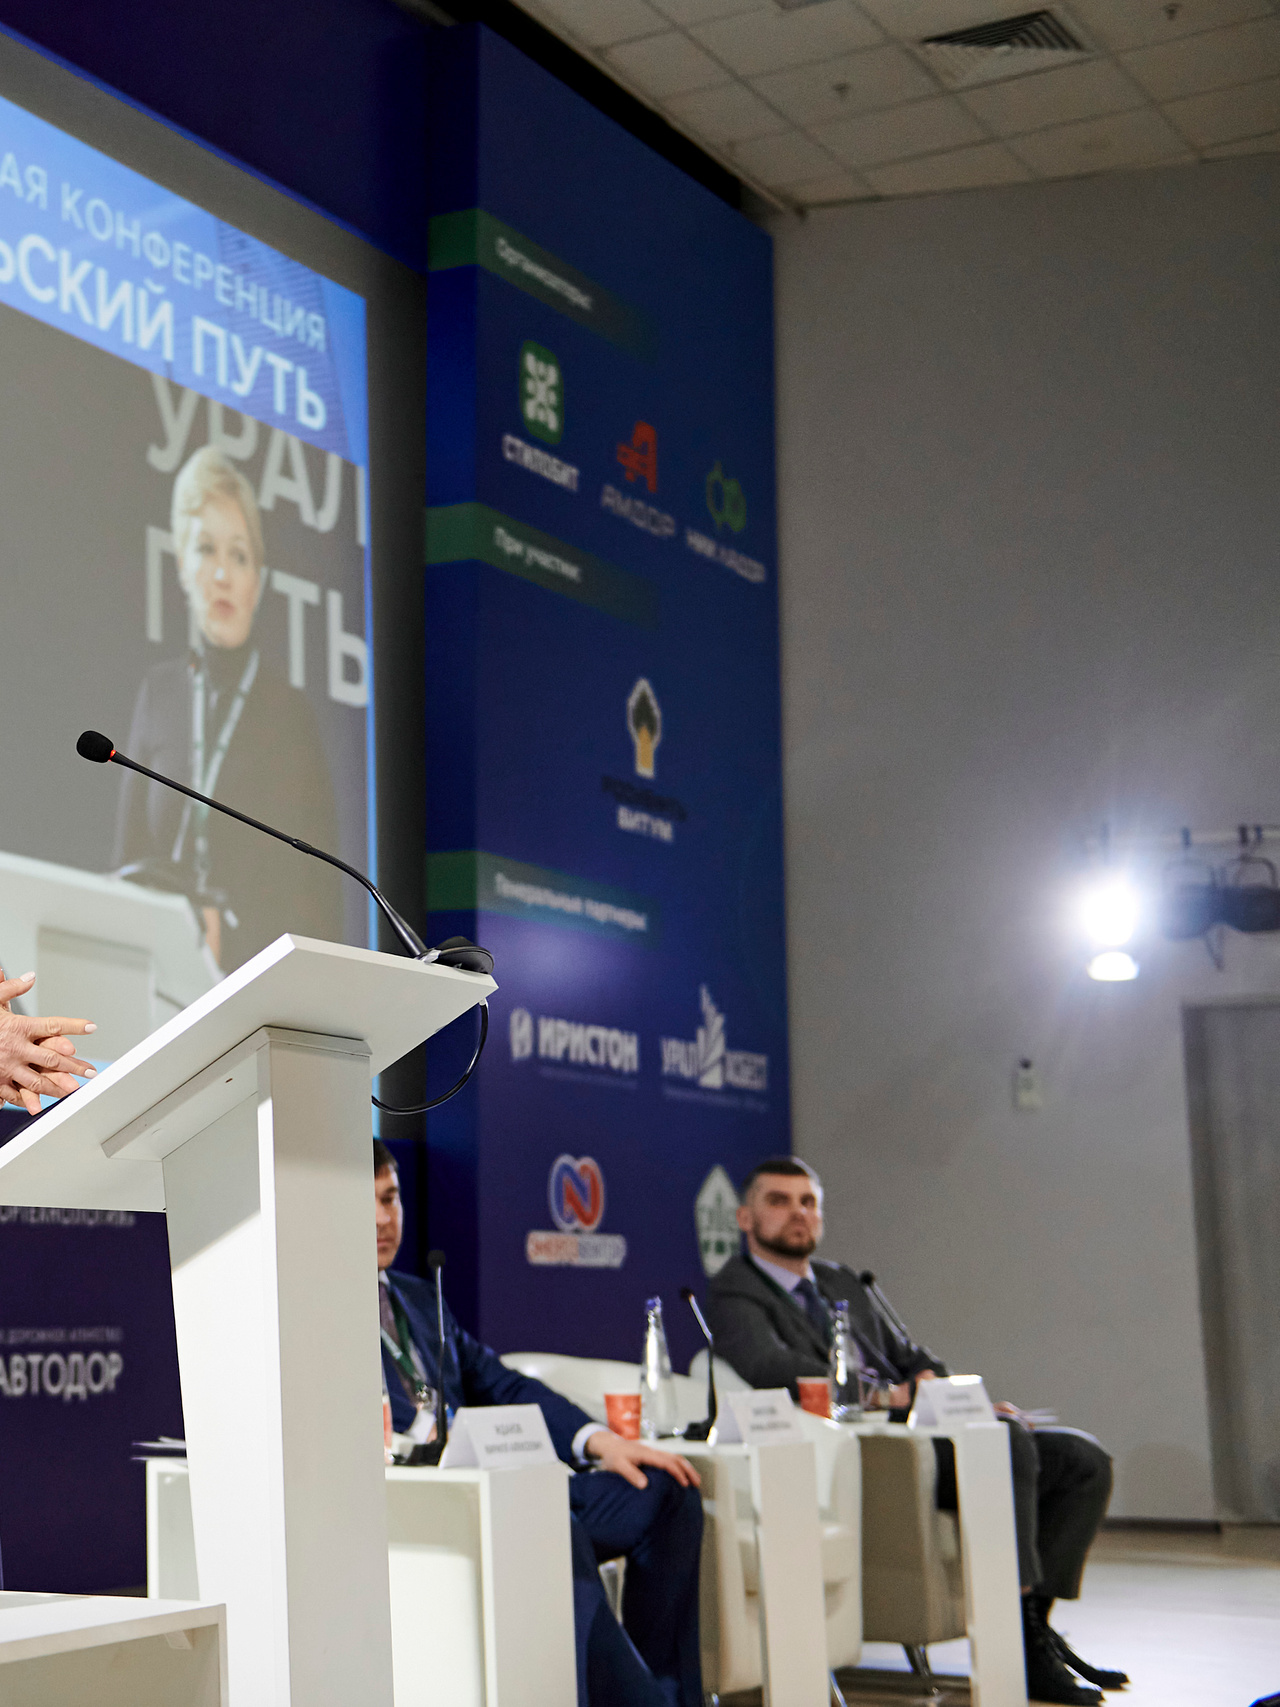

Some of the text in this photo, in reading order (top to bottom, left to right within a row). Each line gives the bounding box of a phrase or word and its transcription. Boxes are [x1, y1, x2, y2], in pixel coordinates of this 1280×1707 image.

[61, 181, 327, 354] КОНФЕРЕНЦИЯ
[191, 316, 328, 432] ПУТЬ
[147, 525, 369, 708] ПТЬ
[538, 1015, 638, 1074] ИРИСТОН
